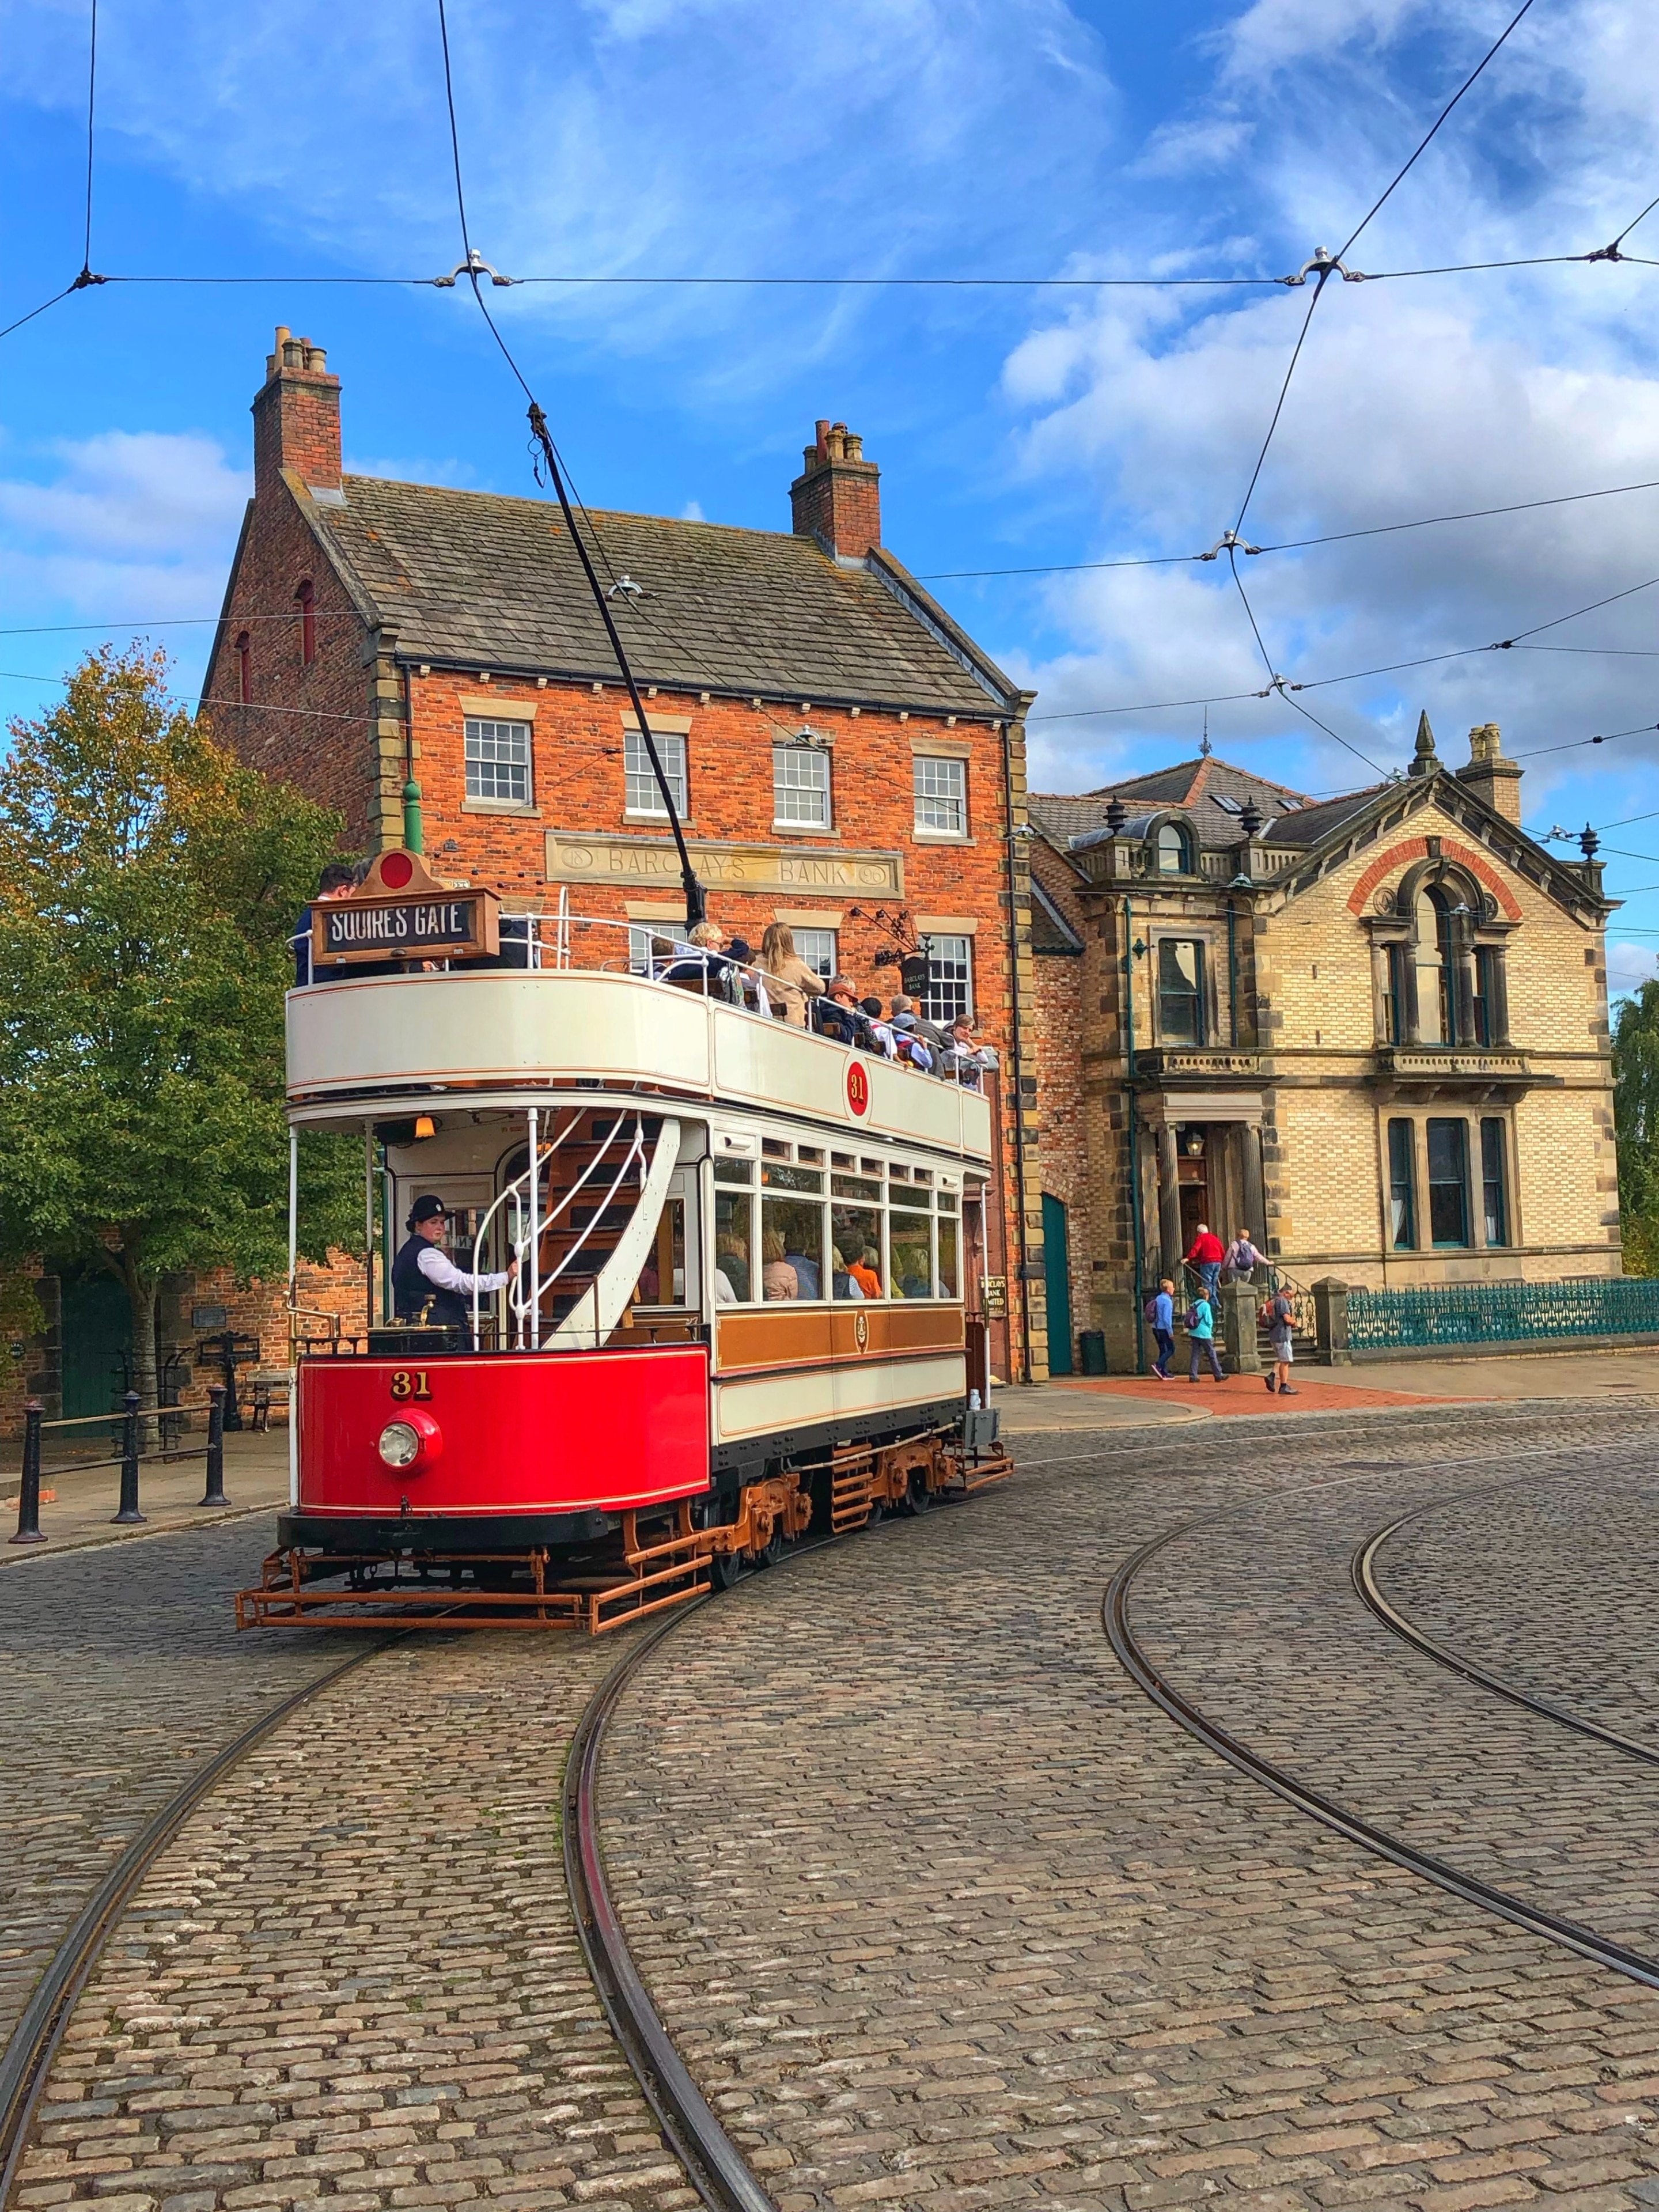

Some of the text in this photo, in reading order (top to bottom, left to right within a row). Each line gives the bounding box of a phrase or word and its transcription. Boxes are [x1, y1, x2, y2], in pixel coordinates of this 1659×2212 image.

[570, 850, 583, 865] 18
[609, 849, 846, 885] BARCAYS BANK
[863, 867, 882, 883] 96
[331, 903, 463, 942] SQUIRES GATE
[904, 974, 926, 984] BARCLAYS
[909, 983, 921, 991] BANK
[850, 1074, 864, 1101] 31
[981, 1280, 1005, 1289] BRCLAYS
[987, 1289, 1001, 1297] ANK
[392, 1372, 431, 1399] 31
